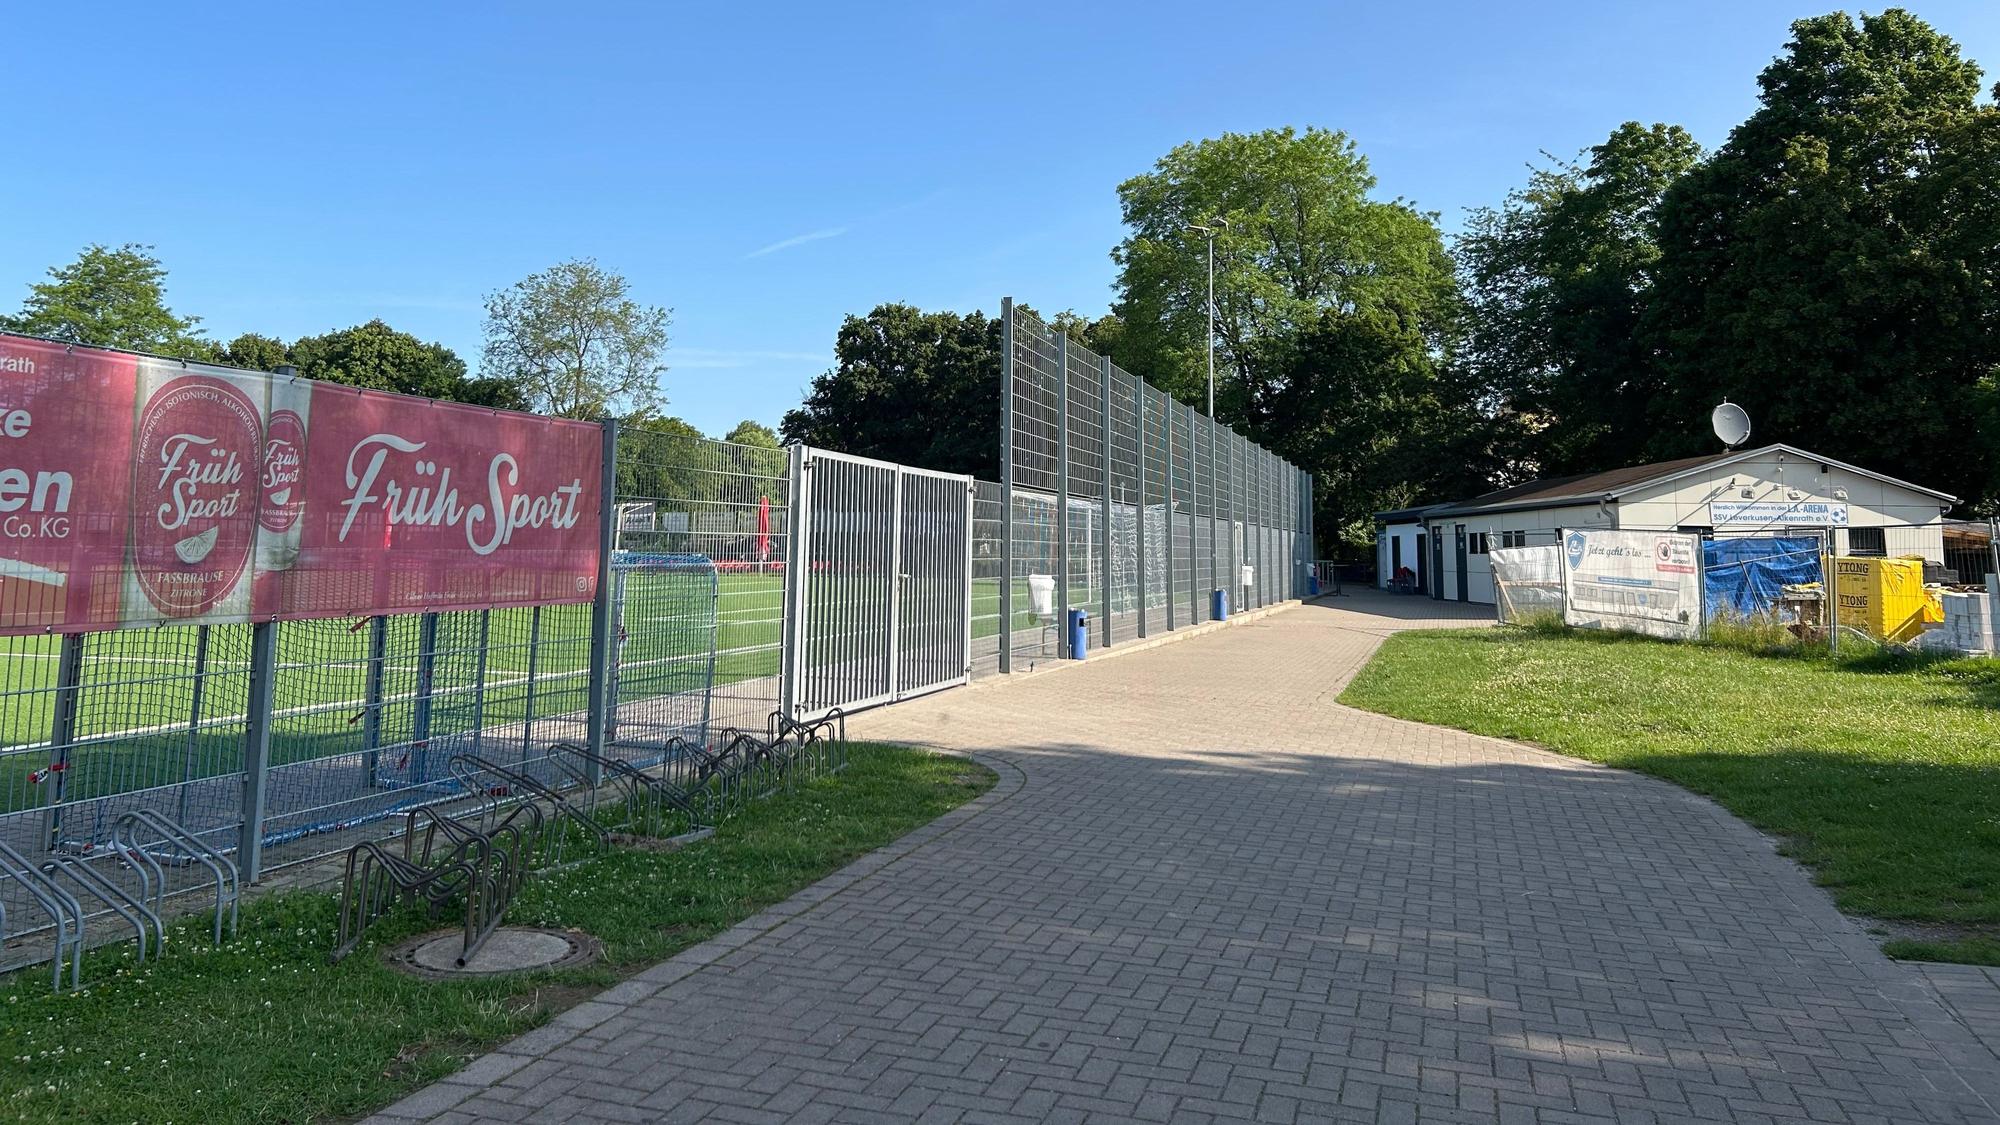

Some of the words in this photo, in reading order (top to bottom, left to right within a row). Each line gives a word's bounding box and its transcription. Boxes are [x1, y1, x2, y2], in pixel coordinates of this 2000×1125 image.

[158, 433, 243, 490] Früh
[264, 439, 300, 464] Früh
[263, 461, 300, 488] Sport
[157, 477, 240, 530] Sport
[339, 434, 463, 542] Früh
[465, 453, 582, 555] Sport
[4, 516, 36, 538] Co.
[40, 517, 70, 538] KG
[1587, 545, 1606, 556] Jetzt
[158, 570, 224, 584] FASSBRAUSE
[1837, 562, 1869, 574] YTONG
[170, 588, 208, 597] ZITRONE
[1839, 594, 1868, 606] YTONG
